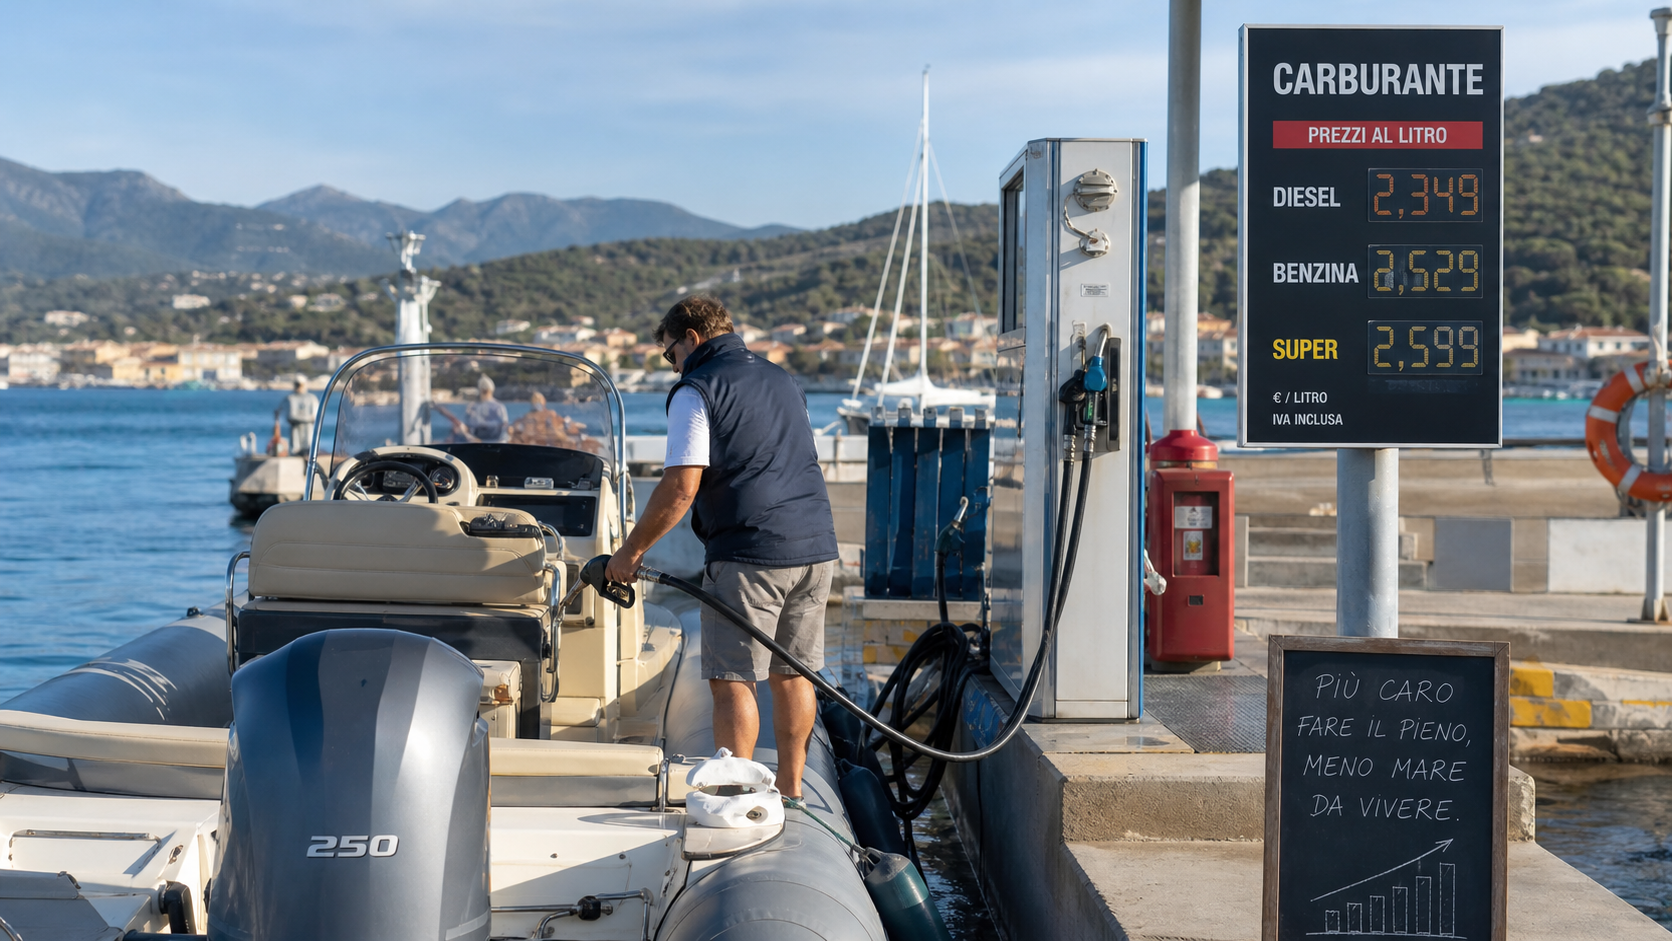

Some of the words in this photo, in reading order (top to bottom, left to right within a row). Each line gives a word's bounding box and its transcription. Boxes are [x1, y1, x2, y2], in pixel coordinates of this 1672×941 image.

[1273, 62, 1484, 95] CARBURANTE
[1308, 126, 1366, 144] PREZZI
[1371, 126, 1393, 144] AL
[1399, 126, 1448, 144] LITRO
[1273, 186, 1341, 208] DIESEL
[1374, 173, 1479, 219] 2,349
[1273, 262, 1360, 284] BENZINA
[1374, 250, 1479, 295] 2,529
[1272, 338, 1339, 360] SUPER
[1374, 326, 1479, 372] 2,599
[1272, 391, 1282, 404] €
[1285, 391, 1291, 404] /
[1294, 391, 1328, 404] LITRO
[1272, 413, 1291, 426] IVA
[1294, 413, 1343, 426] INCLUSA
[1315, 671, 1360, 700] PIÙ
[1379, 679, 1454, 704] CARO
[1297, 715, 1354, 738] FARE
[1400, 717, 1471, 748] PIENO,
[1303, 754, 1374, 777] MENO
[1391, 758, 1467, 782] MARE
[1310, 794, 1344, 818] DA
[1360, 794, 1460, 822] VIVERE.
[306, 834, 399, 858] 250
